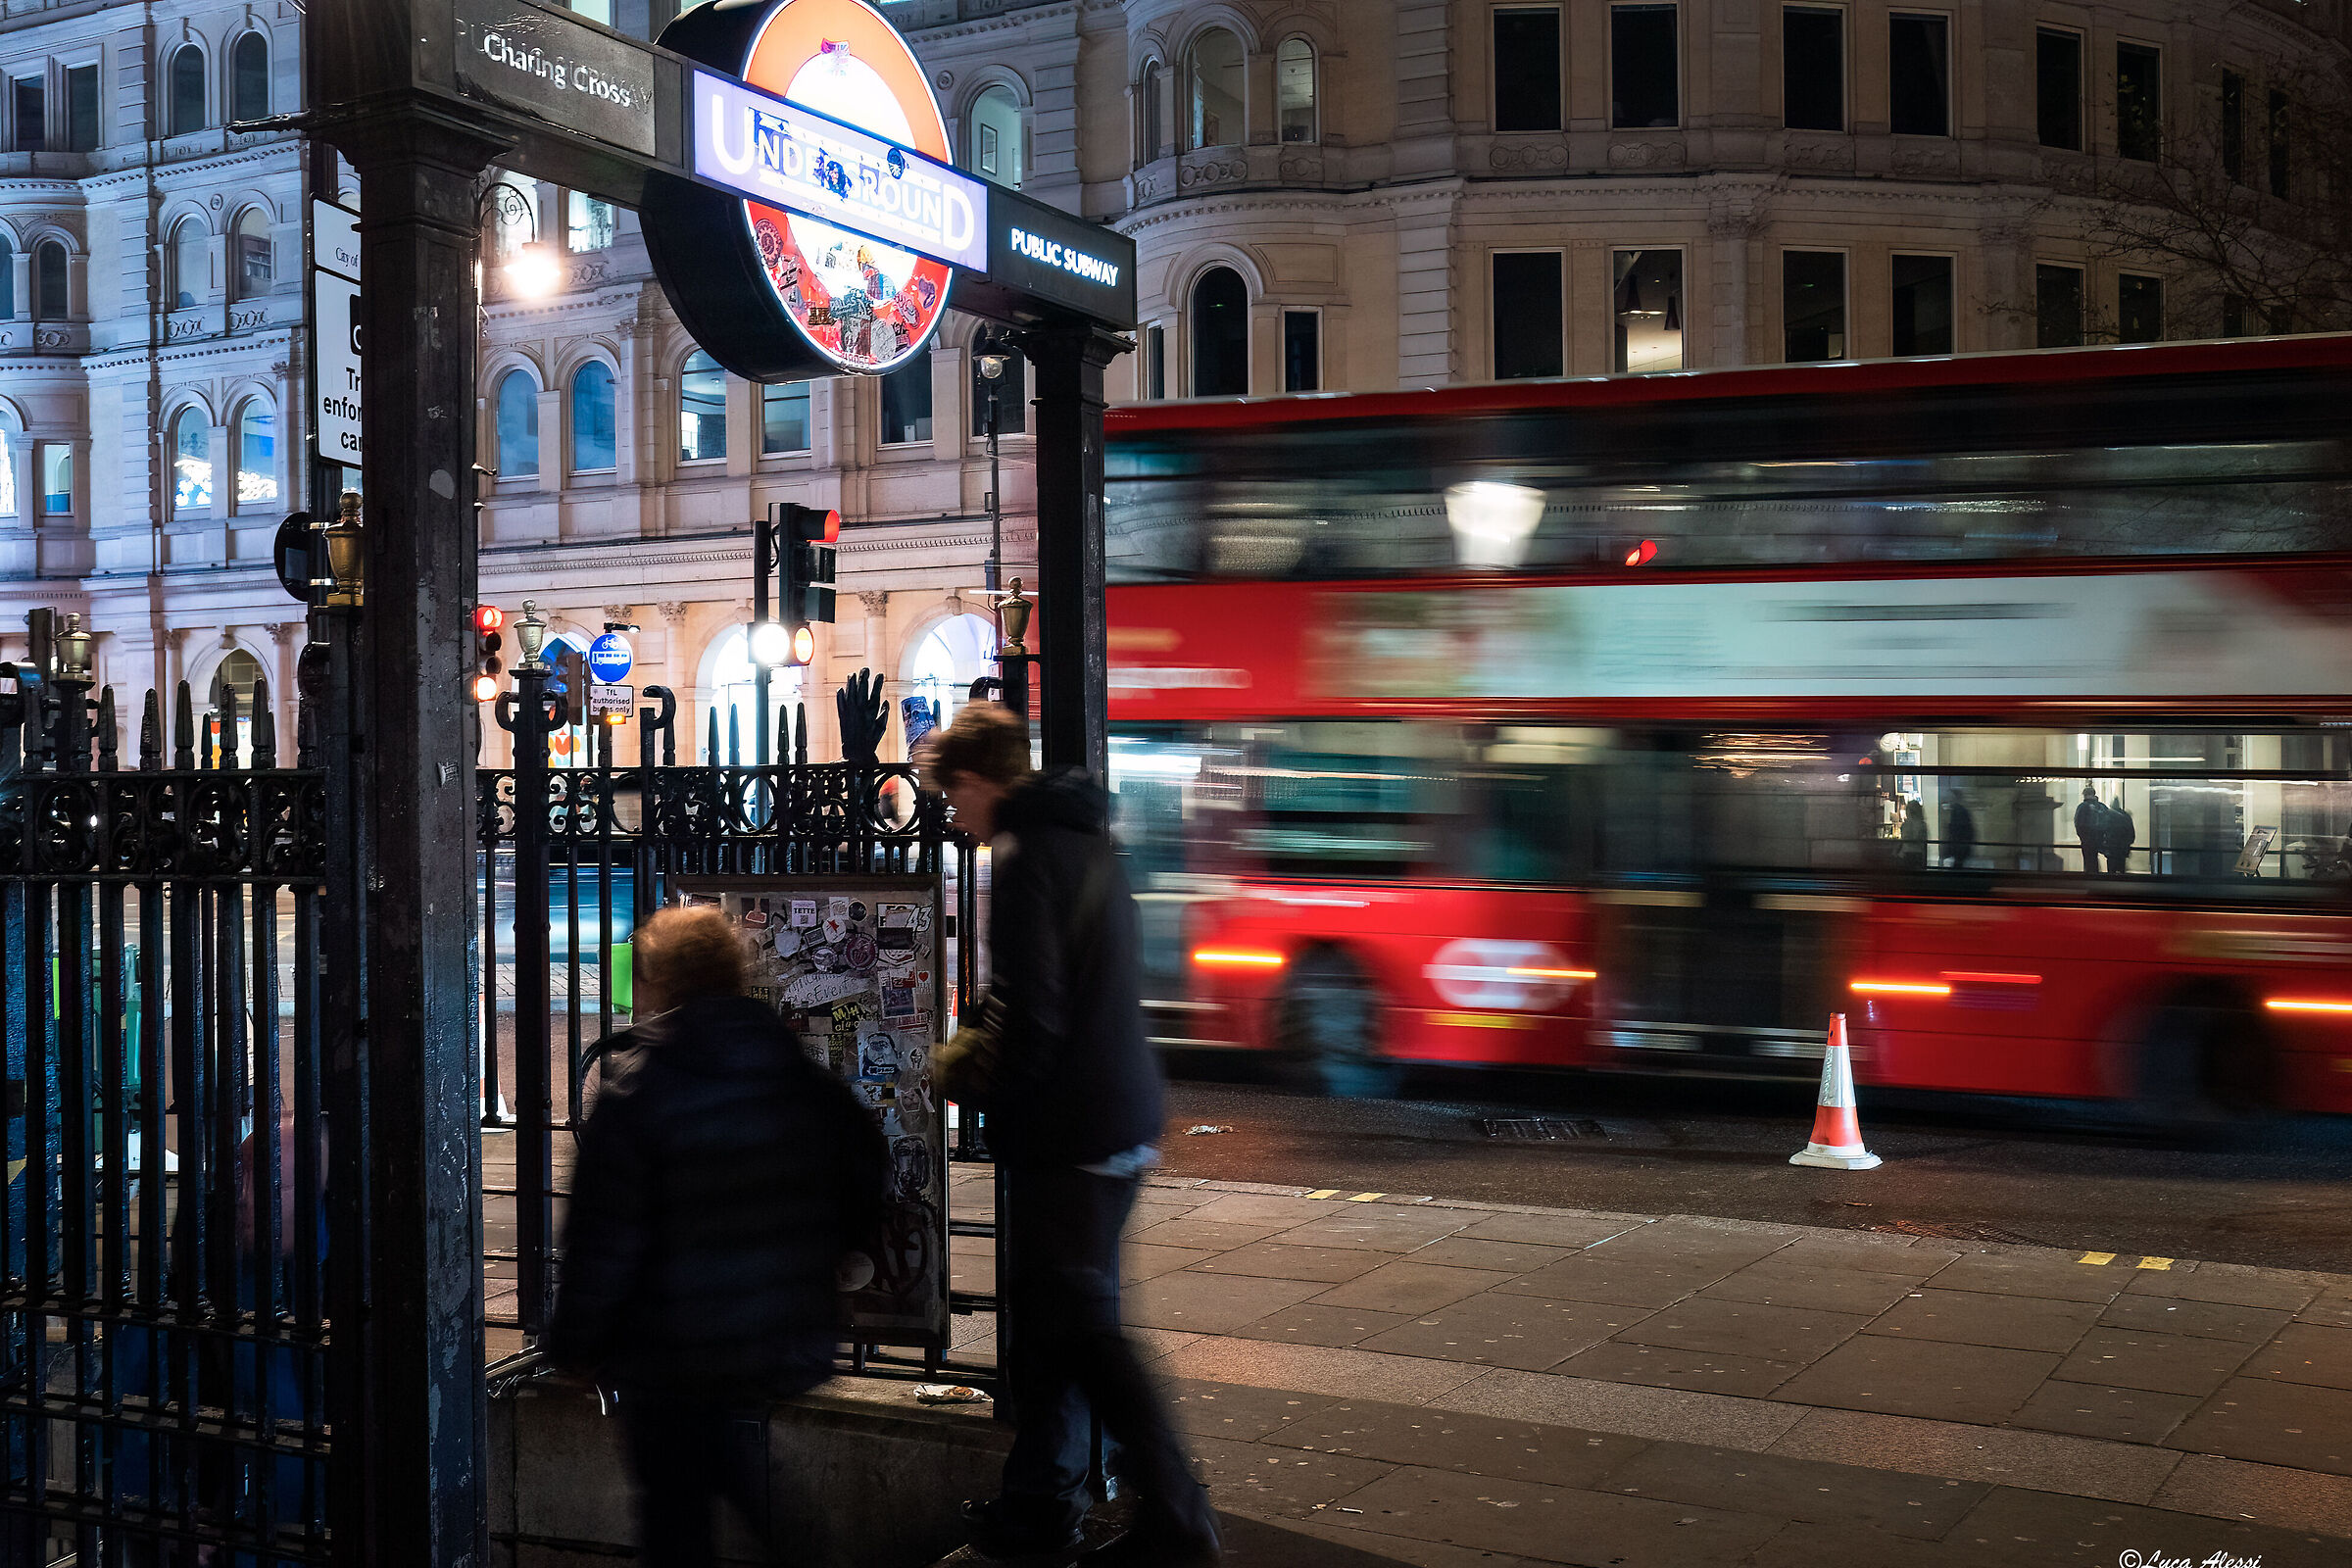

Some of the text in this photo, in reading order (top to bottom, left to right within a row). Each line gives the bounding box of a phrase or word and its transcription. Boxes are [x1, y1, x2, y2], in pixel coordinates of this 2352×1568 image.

[483, 32, 566, 90] Charing
[571, 65, 632, 108] Cross
[711, 94, 976, 252] UNDEGROUND
[336, 247, 349, 268] City
[1011, 227, 1119, 287] PUBLIC SUBWAY
